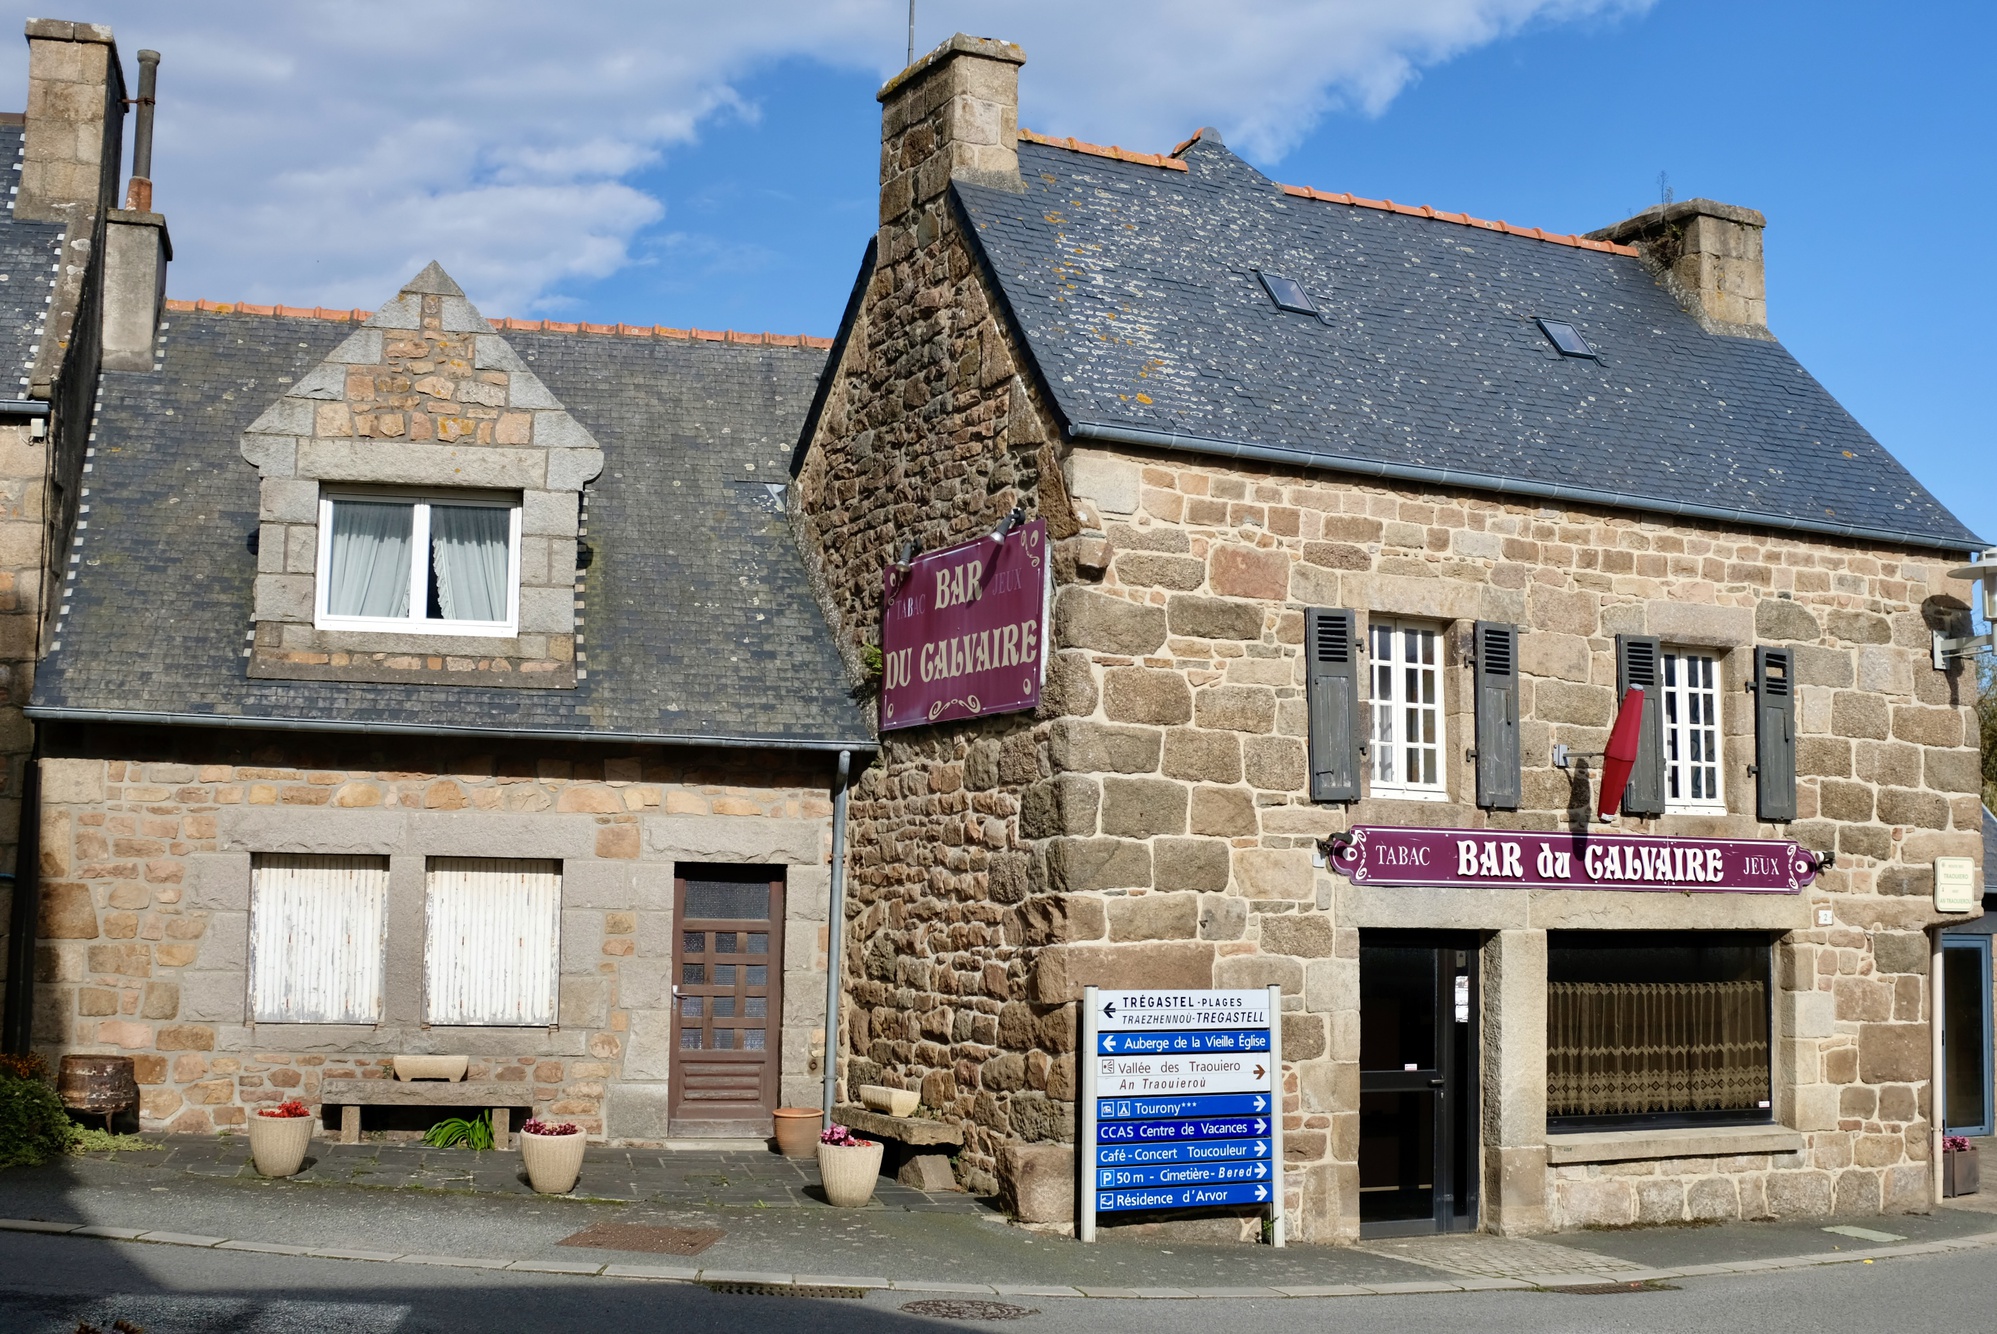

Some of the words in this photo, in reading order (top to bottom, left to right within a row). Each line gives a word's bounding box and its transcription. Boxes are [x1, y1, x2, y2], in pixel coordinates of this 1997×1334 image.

[896, 594, 926, 620] TABAC
[935, 559, 983, 610] BAR
[992, 568, 1022, 596] JEUX
[885, 647, 912, 690] DU
[920, 619, 1037, 683] CALVAIRE
[1375, 845, 1431, 866] TABAC
[1456, 839, 1524, 878] BAR
[1536, 842, 1571, 879] du
[1584, 844, 1724, 883] CALVAIRE
[1743, 856, 1780, 876] JEUX
[1124, 1037, 1170, 1052] Auberge
[1174, 1036, 1188, 1048] de
[1192, 1035, 1201, 1048] la
[1205, 1034, 1235, 1048] Vieille
[1238, 1033, 1266, 1050] Église
[1117, 1062, 1151, 1074] Vallée
[1160, 1061, 1180, 1073] des
[1189, 1059, 1241, 1072] Traouiero
[1119, 1078, 1135, 1090] An
[1142, 1076, 1206, 1090] Traouieroù
[1100, 1126, 1134, 1139] CCAS
[1139, 1125, 1175, 1137] Centre
[1180, 1123, 1195, 1135] de
[1200, 1122, 1248, 1135] Vacances
[1187, 1144, 1247, 1158] Toucouleur
[1116, 1172, 1131, 1184] 50
[1116, 1192, 1173, 1207] Résidence
[1182, 1189, 1228, 1203] d'Arvor
